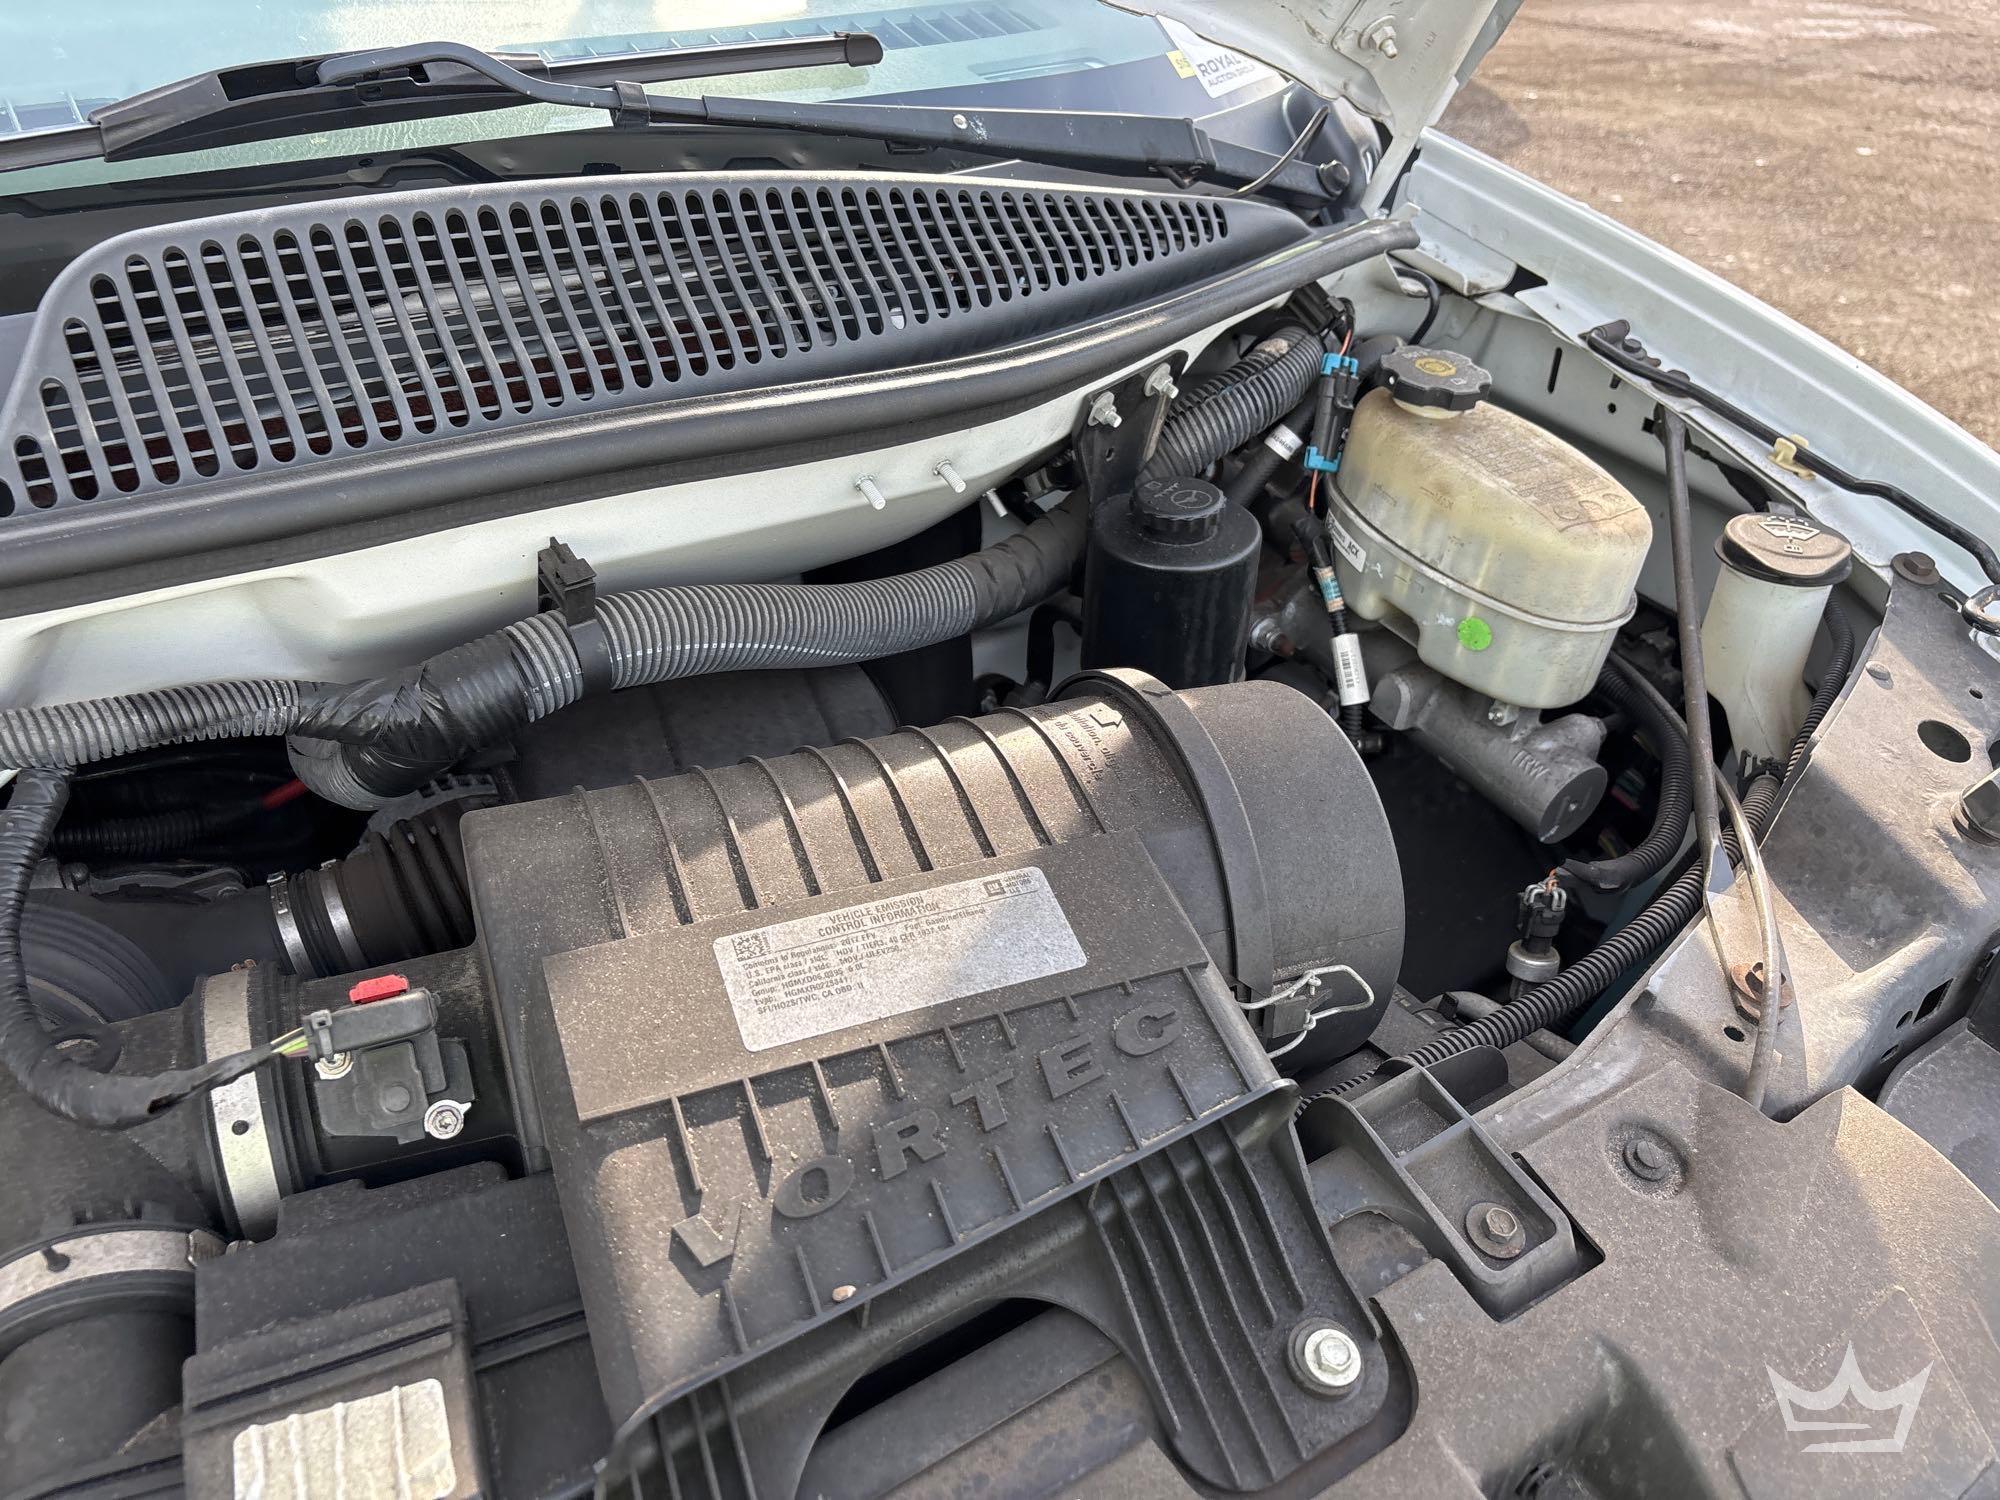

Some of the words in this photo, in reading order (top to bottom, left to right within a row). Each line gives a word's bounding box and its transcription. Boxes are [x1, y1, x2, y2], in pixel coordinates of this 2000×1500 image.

[1197, 53, 1241, 78] ROYAL
[818, 919, 867, 937] CONTROL
[870, 902, 940, 924] INFORMATION
[829, 908, 872, 925] VEHICLE
[875, 895, 923, 913] EMISSION
[670, 1004, 1184, 1268] VORTEC
